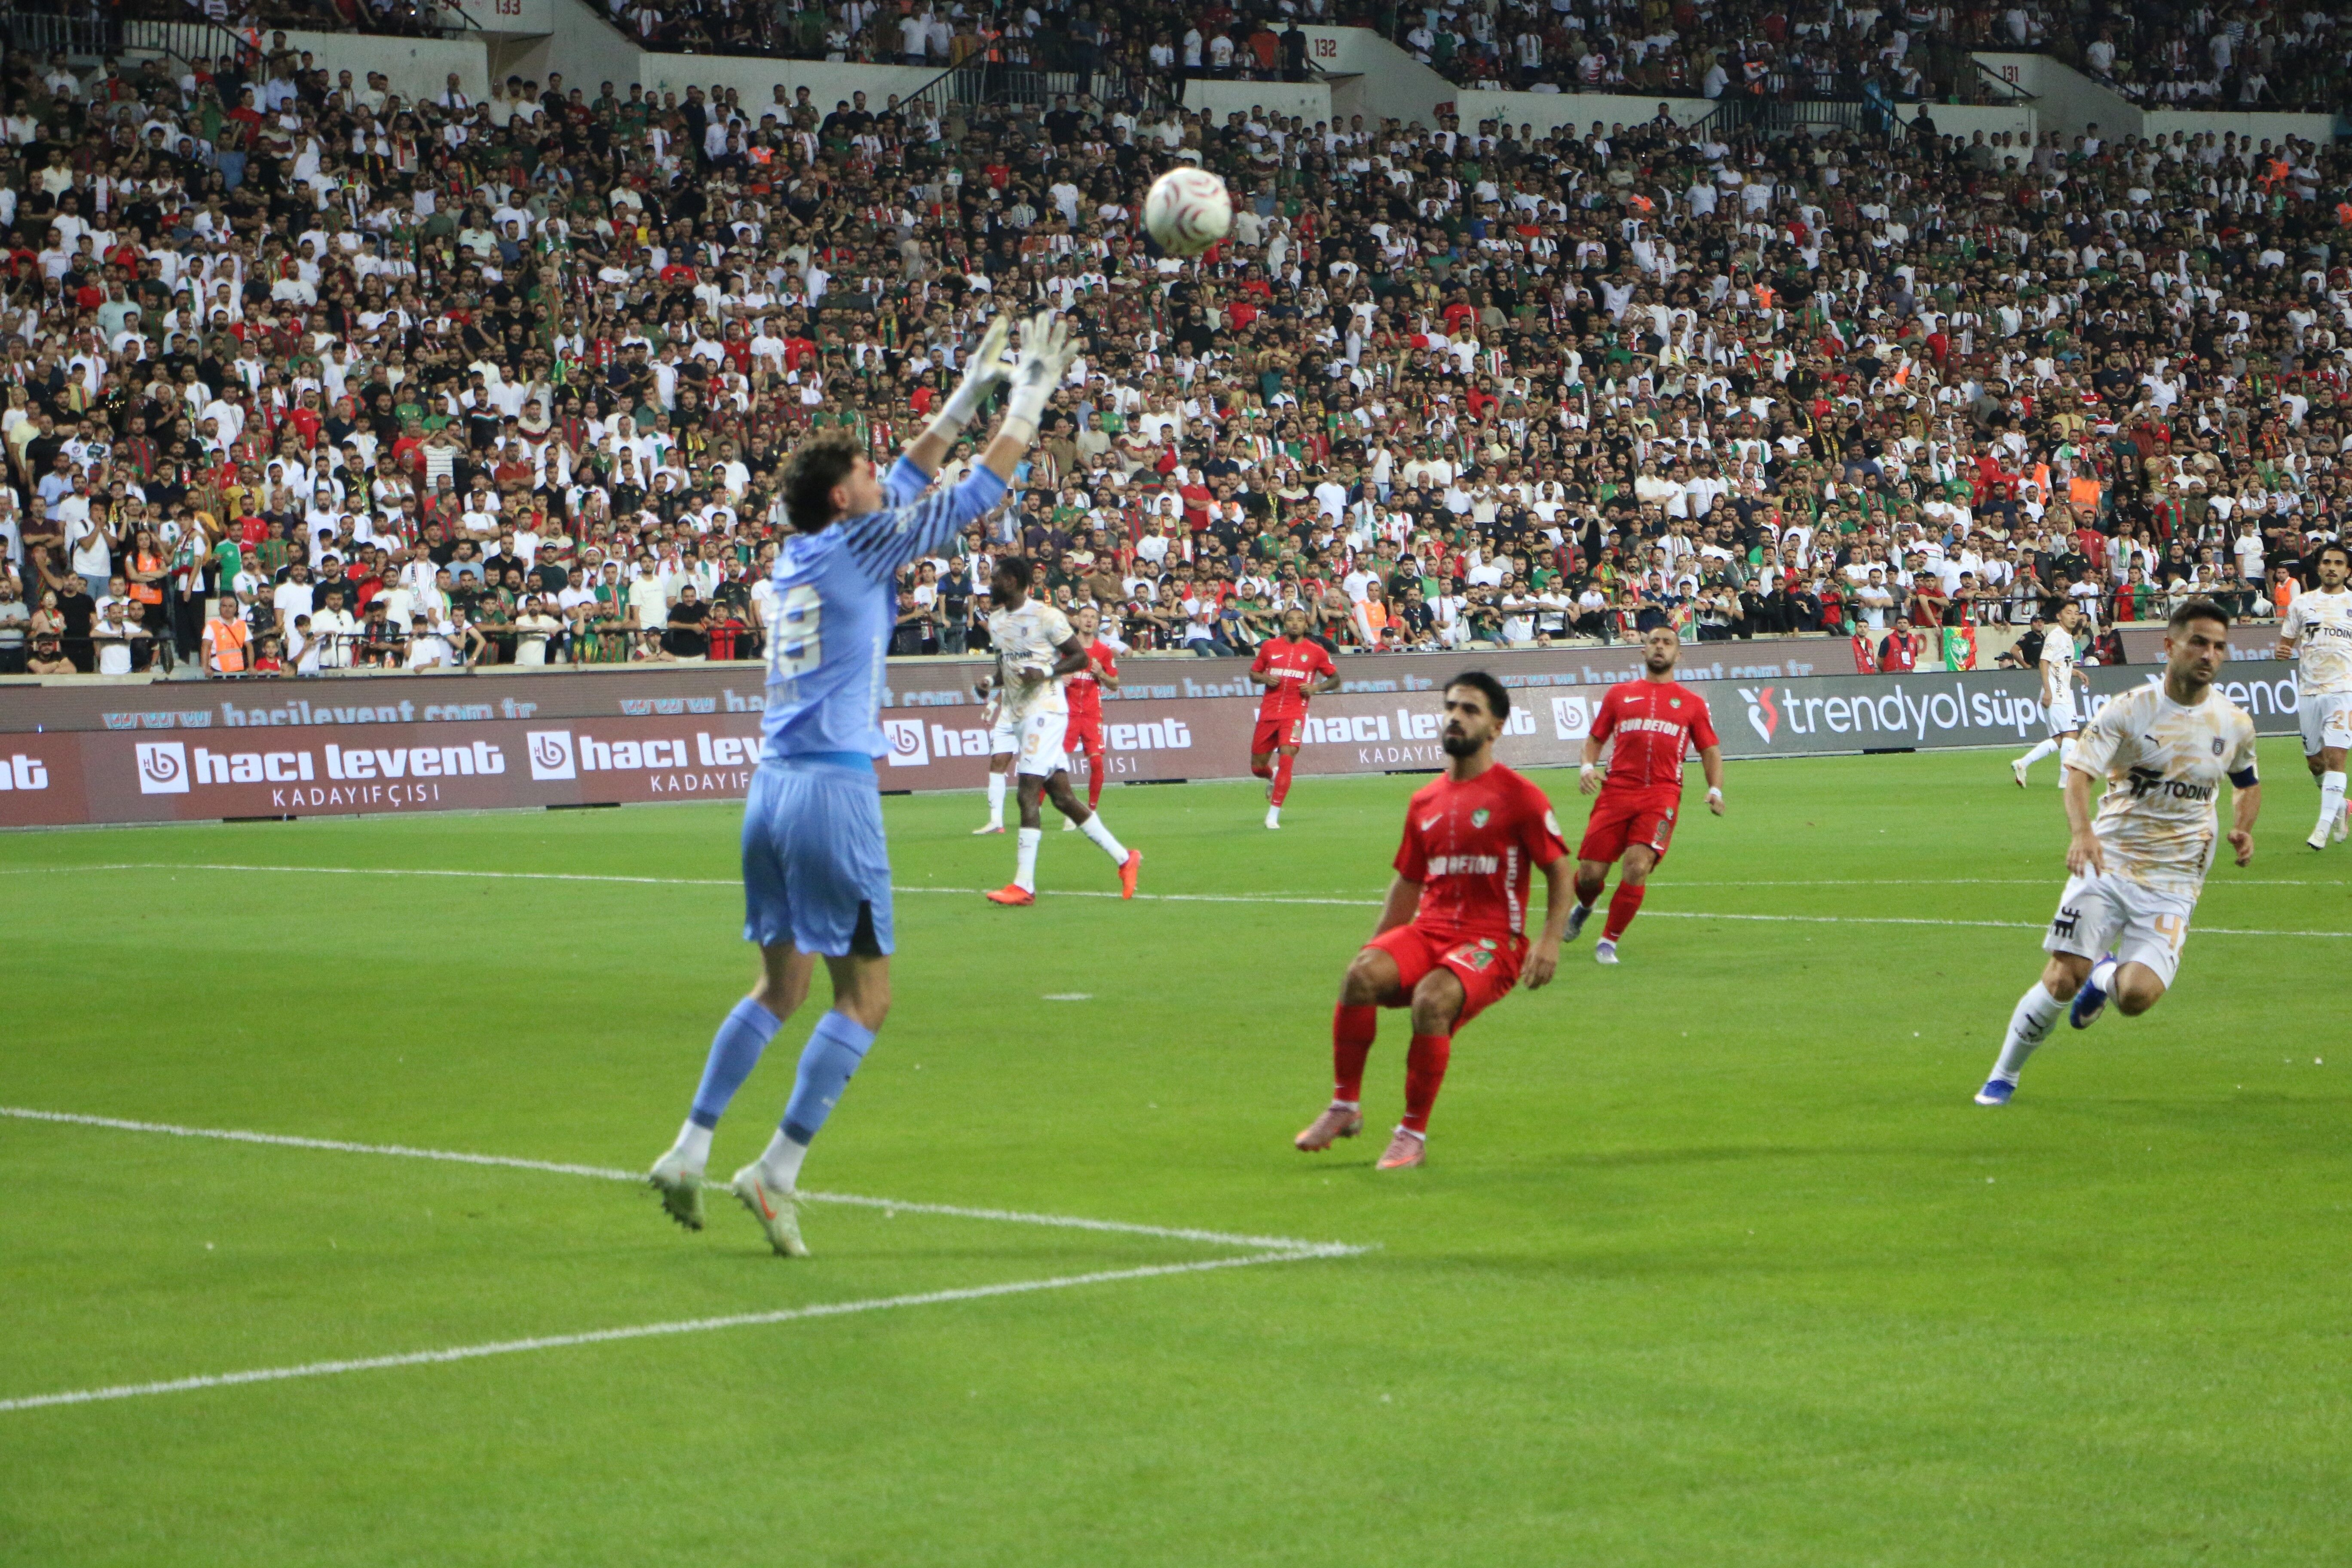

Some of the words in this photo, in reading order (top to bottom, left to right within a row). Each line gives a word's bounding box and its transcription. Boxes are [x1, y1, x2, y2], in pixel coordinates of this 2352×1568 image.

[1314, 38, 1336, 57] 132
[2002, 65, 2019, 83] 131
[1782, 682, 1969, 741] trendyol
[1620, 718, 1643, 734] SUR
[1642, 719, 1681, 737] BETON
[931, 724, 990, 757] ha
[1025, 734, 1040, 755] 3
[579, 735, 689, 771] hacı
[697, 732, 766, 766] lev
[1360, 745, 1443, 764] KADAYIF
[194, 747, 315, 784] hacı
[325, 741, 505, 780] levent
[651, 772, 749, 792] KADAYIF
[1654, 819, 1669, 841] 9
